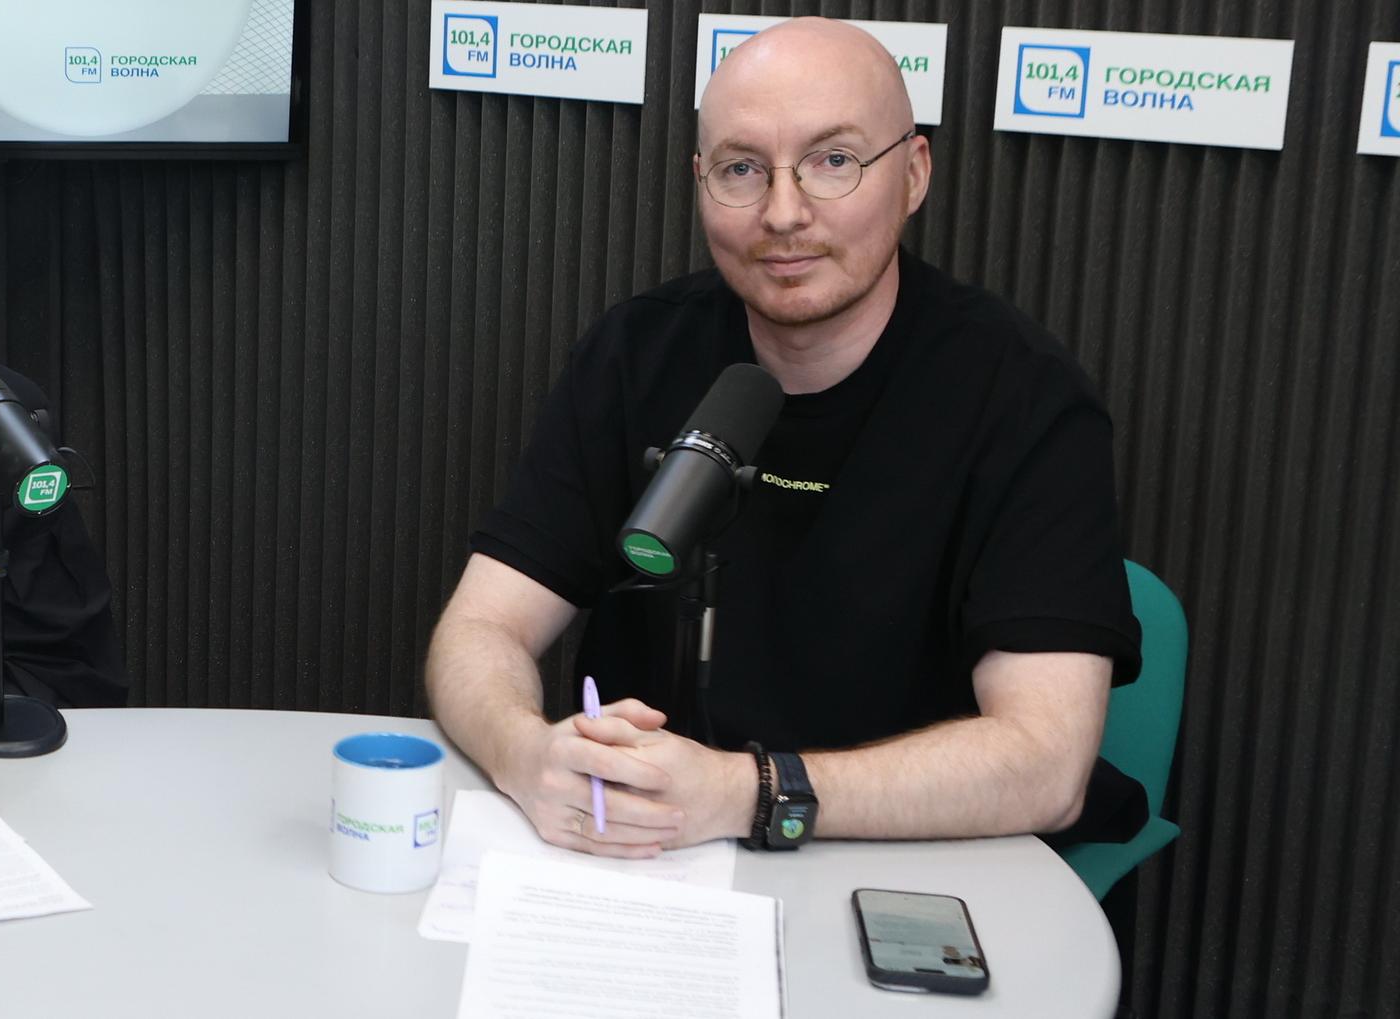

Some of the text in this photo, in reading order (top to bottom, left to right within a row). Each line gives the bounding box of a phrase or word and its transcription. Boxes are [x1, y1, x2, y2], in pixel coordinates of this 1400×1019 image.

[450, 30, 490, 47] 101,4
[510, 33, 632, 55] ГОРОДСКАЯ
[69, 55, 98, 66] 101,4
[111, 56, 197, 67] ГОРОДСКАЯ
[468, 50, 489, 62] FM
[509, 52, 577, 70] ВОЛНА
[111, 68, 160, 77] ВОЛНА
[1025, 62, 1080, 83] 101,4
[1105, 66, 1271, 93] ГОРОДСКАЯ
[1048, 86, 1076, 100] FM
[1103, 89, 1194, 111] ВОЛНА
